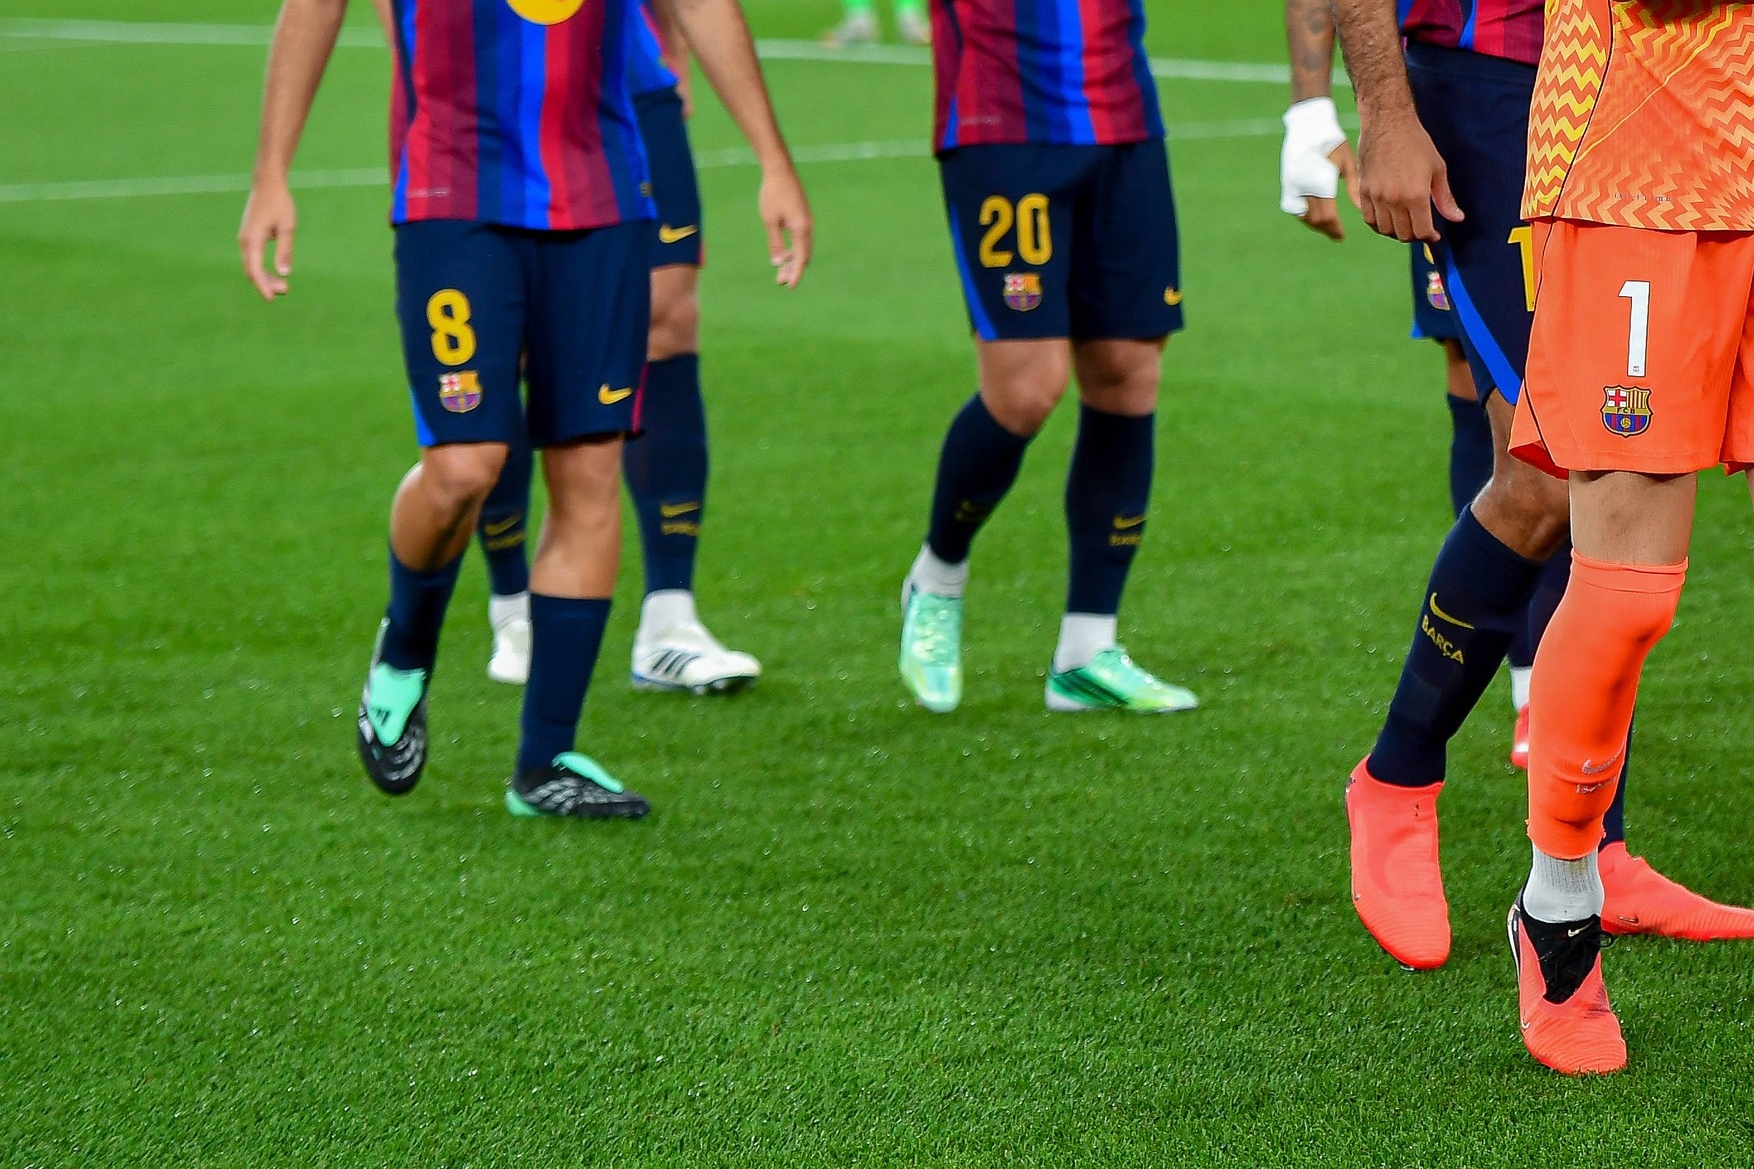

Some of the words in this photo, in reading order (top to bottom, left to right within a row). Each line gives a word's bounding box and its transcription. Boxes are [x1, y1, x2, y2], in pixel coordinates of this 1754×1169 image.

[979, 192, 1054, 269] 20
[426, 288, 477, 366] 8
[1618, 280, 1651, 378] 1
